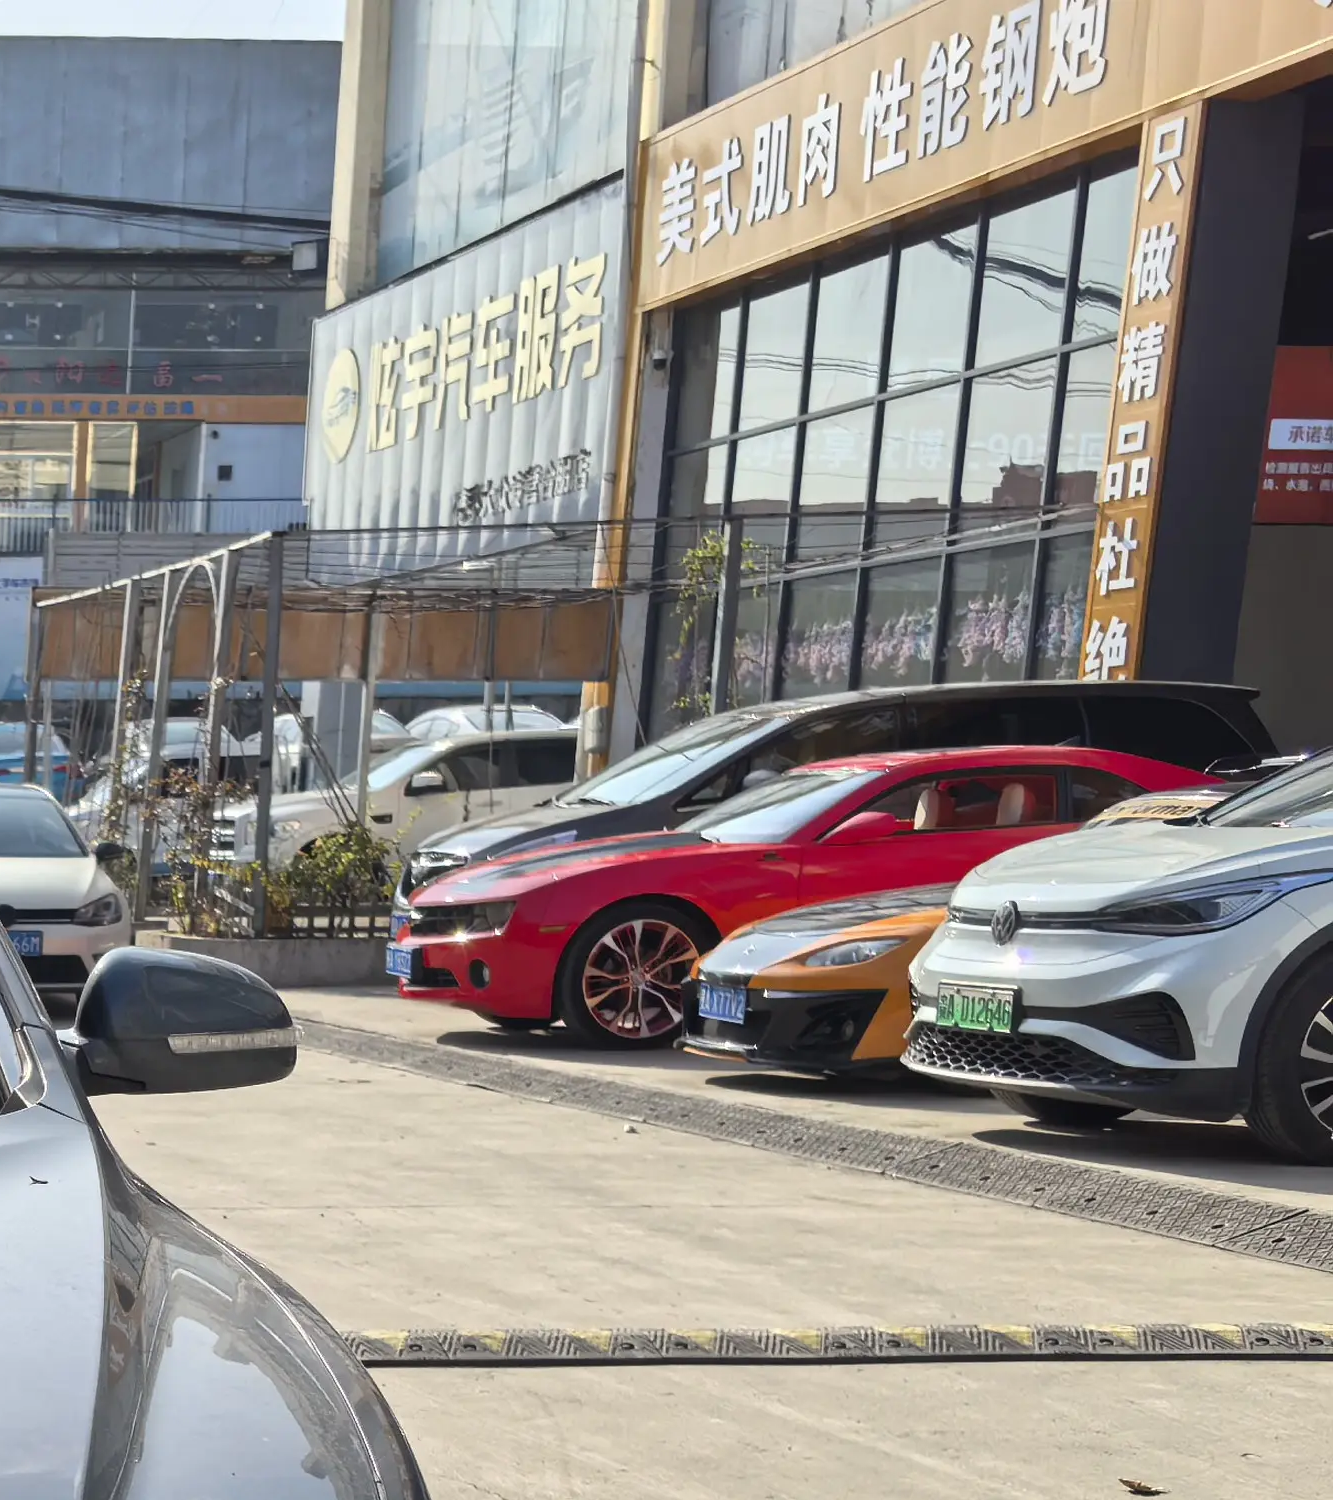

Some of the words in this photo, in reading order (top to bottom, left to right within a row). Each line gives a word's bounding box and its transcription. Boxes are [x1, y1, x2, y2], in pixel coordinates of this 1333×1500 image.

[655, 92, 843, 268] 美式肌肉
[860, 0, 1109, 183] 性能钢炮
[365, 252, 609, 454] 炫宇汽车服务
[1084, 114, 1189, 681] 只做精品杜绝
